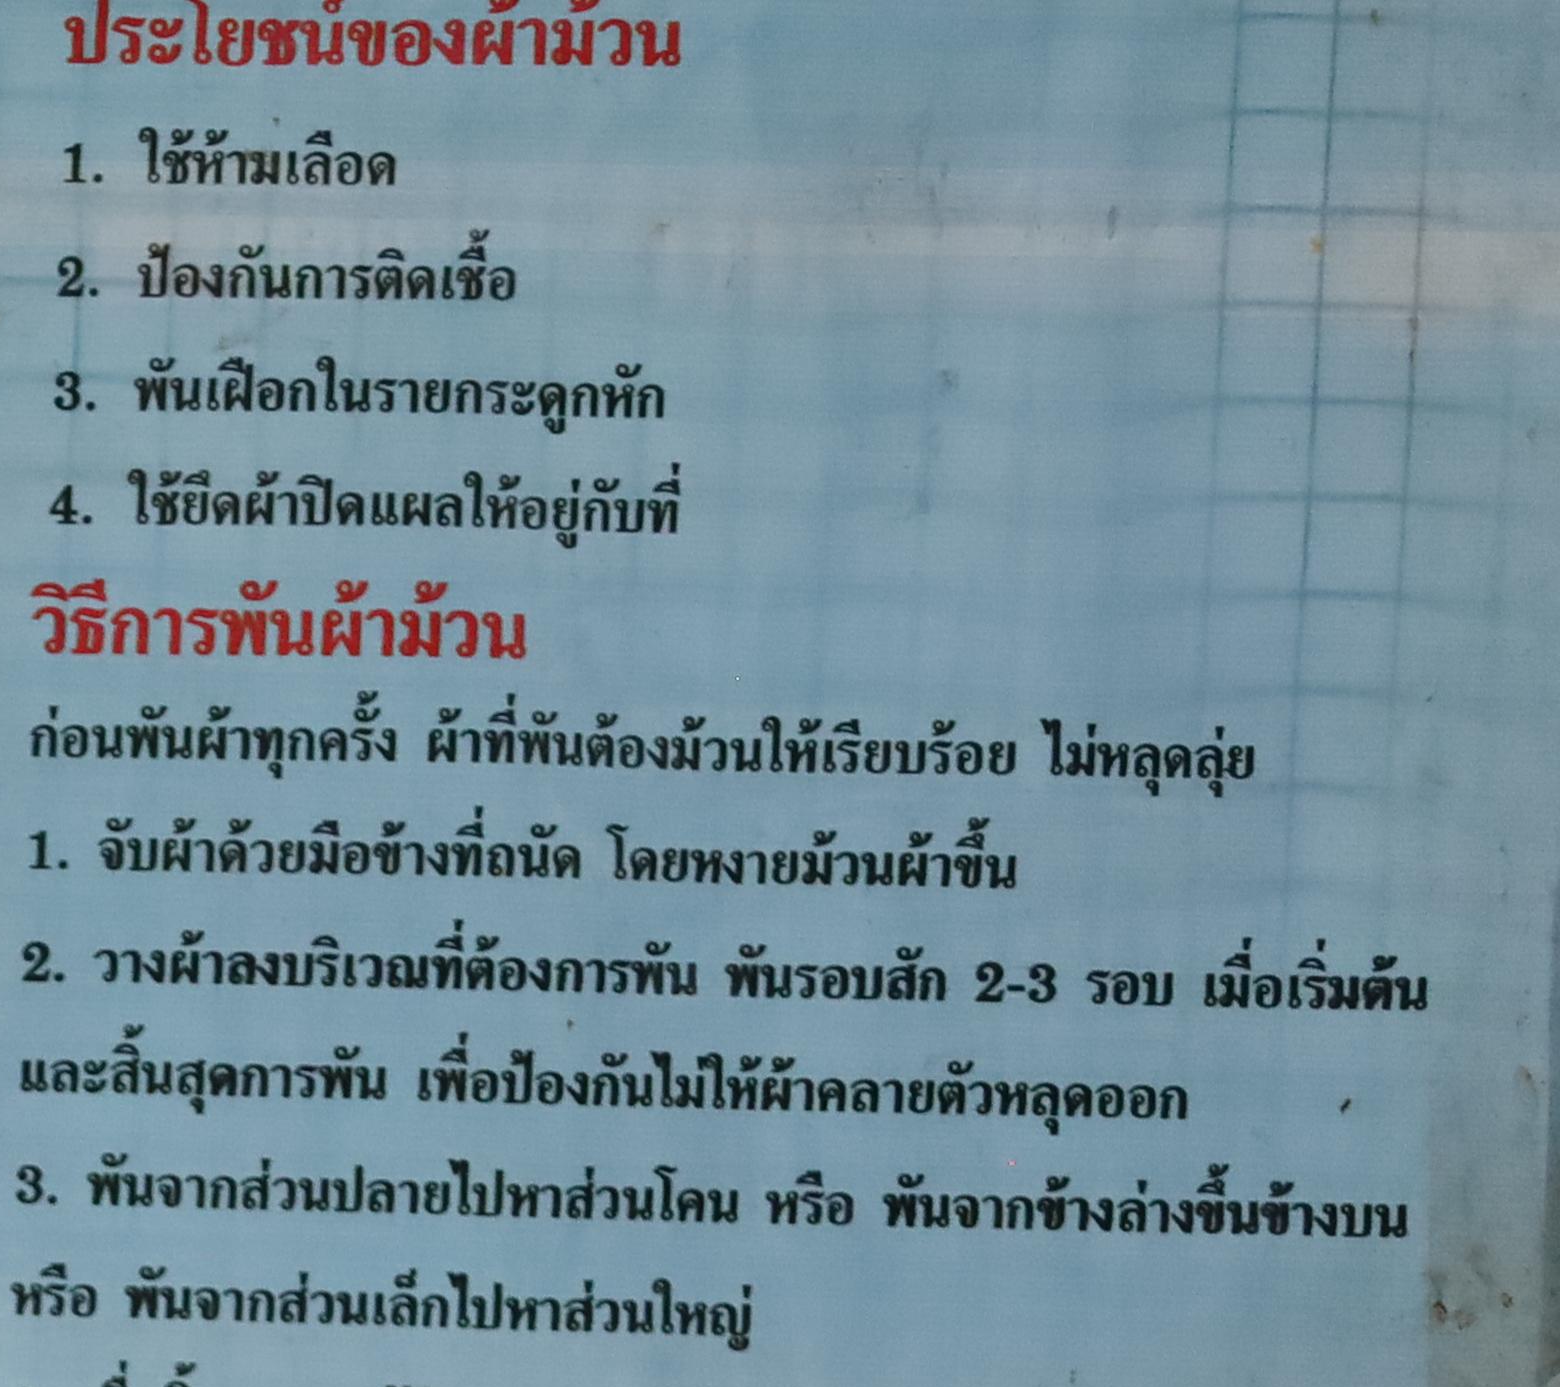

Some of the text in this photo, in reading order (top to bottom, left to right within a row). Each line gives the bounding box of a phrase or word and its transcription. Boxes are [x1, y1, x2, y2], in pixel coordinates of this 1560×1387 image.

[63, 125, 397, 187] 1. ใช้ห้ามเลือด
[56, 228, 517, 303] 2. ป้องกันการติดเชื้อ
[52, 354, 666, 436] 3. พันเฝือกในรายกระดูกหัก
[48, 461, 682, 551] 4. ใช้ยึดผ้าปิดแผลให้อยู่กับที่
[30, 577, 527, 660] วิธีการพันผ้าม้วน
[29, 689, 1256, 799] ก่อนพันผ้าทุกครั้ง ผ้าที่พันต้องม้วนให้เรียบร้อย ไม่หลุดลุ่ย
[28, 804, 1018, 890] 1. จับผ้าด้วยมือข้างที่ถนัด โดยหงายม้วนผ้าขึ้น
[21, 917, 1429, 1012] 2. วางผ้าลงบริเวณที่ต้องการพัน พันรอบสัก 2-3 รอบ เมื่อเริ่มต้น
[19, 1023, 1189, 1137] และสิ้นสุดการพัน เพื่อป้องกันไม่ให้ผ้าคลายตัวหลุดออก
[14, 1151, 1409, 1240] 3. พันจากส่วนปลายไปหาส่วนโคน หรือ พันจากข้างล่างขึ้นข้างบน
[9, 1261, 753, 1353] หรือ พันจากส่วนเล็กไปหาส่วนใหญ่
